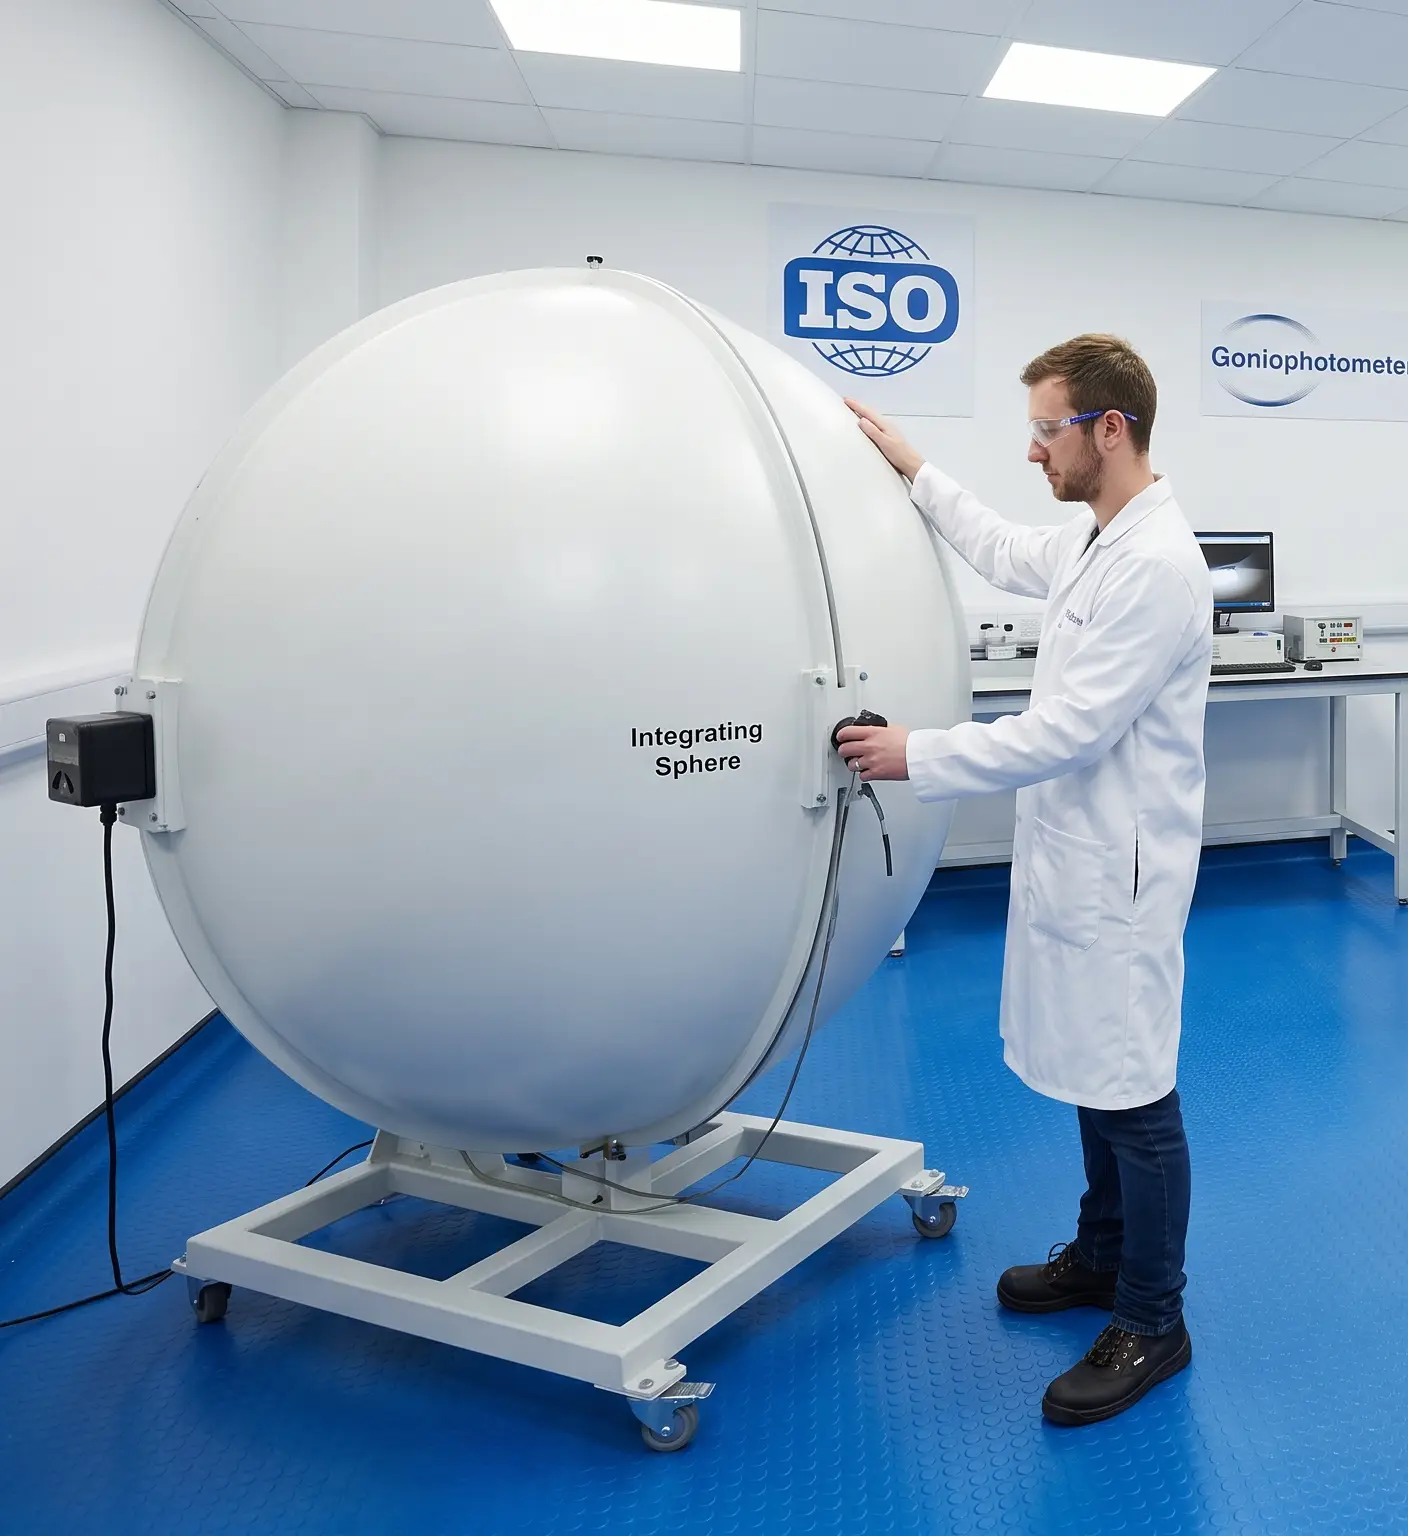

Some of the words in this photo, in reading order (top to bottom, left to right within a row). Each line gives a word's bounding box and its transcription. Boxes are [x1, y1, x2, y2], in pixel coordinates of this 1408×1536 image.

[799, 269, 948, 334] ISO
[631, 721, 763, 749] Integrating
[655, 754, 741, 779] Sphere
